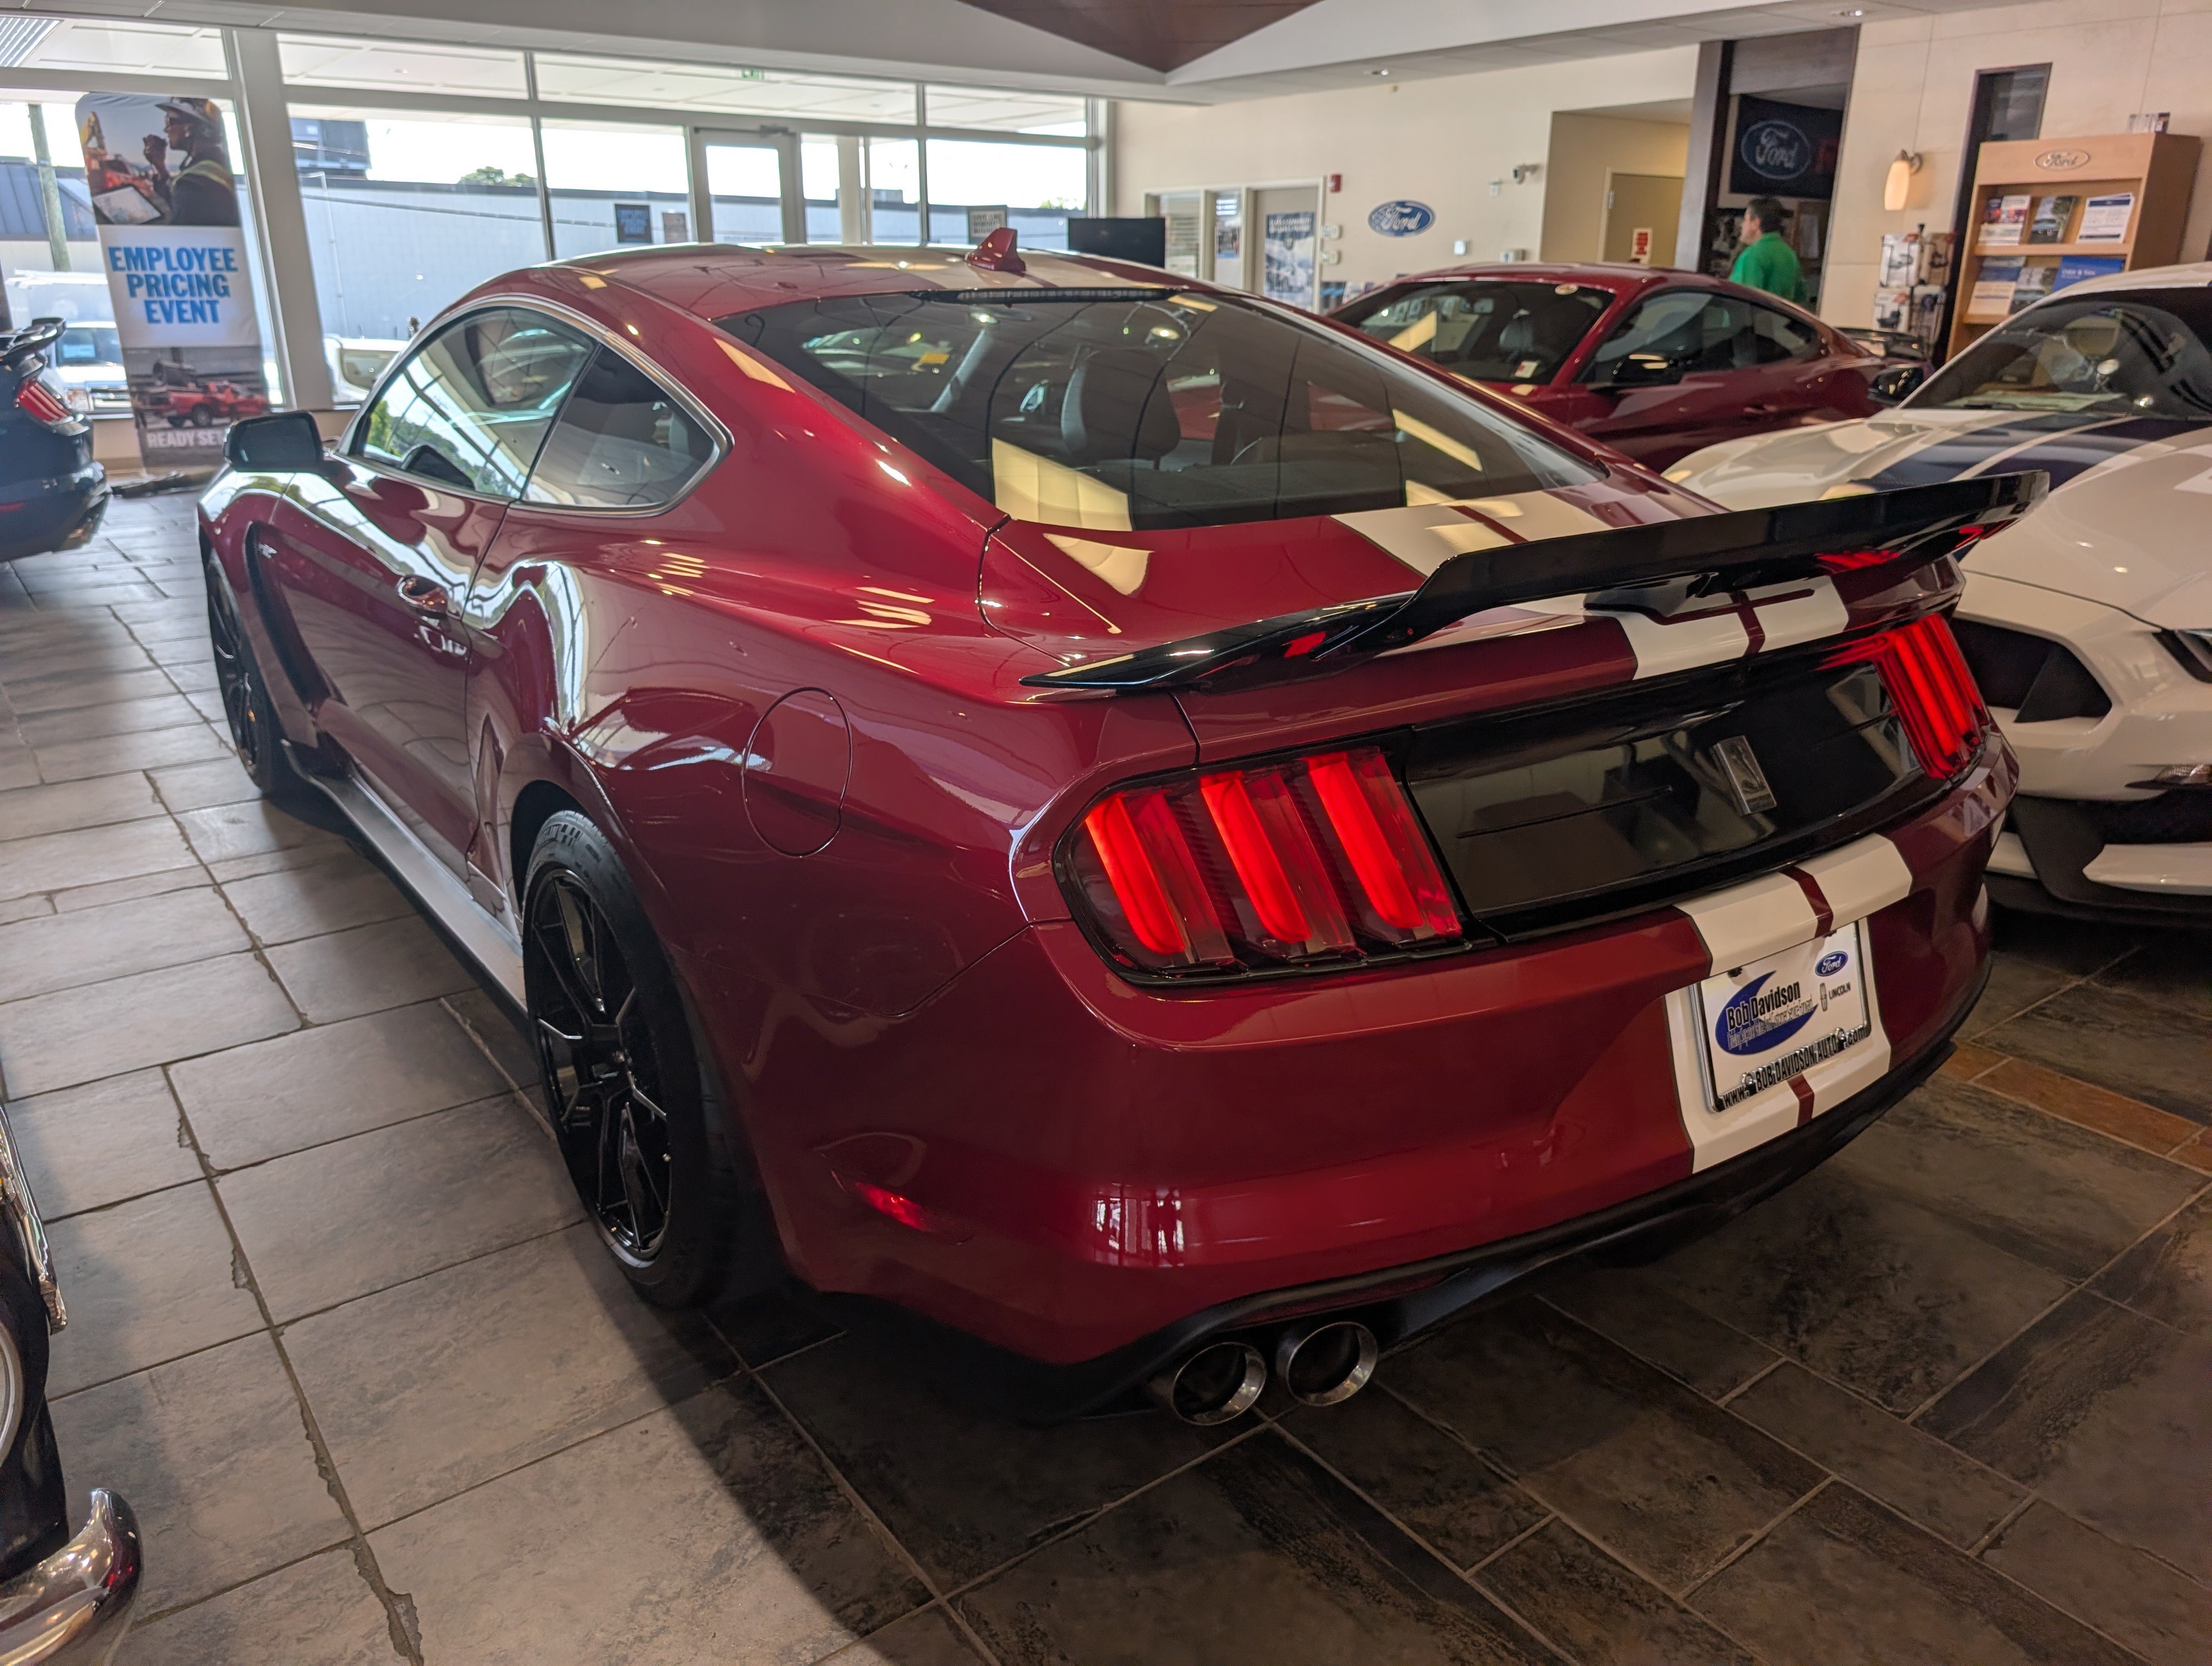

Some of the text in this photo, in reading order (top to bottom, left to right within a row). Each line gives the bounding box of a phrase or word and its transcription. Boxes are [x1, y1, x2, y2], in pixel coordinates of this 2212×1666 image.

[1756, 127, 1799, 169] Ford
[2043, 151, 2079, 166] Ford
[1381, 206, 1423, 230] Ford
[108, 247, 238, 272] EMPLOYEE
[126, 273, 230, 298] PRICING
[144, 299, 220, 324] EVENT
[146, 430, 195, 448] READY
[1822, 955, 1842, 973] Ford
[1828, 982, 1851, 1000] LINCOLN
[1727, 1002, 1750, 1030] Bob
[1751, 981, 1801, 1020] Davidson
